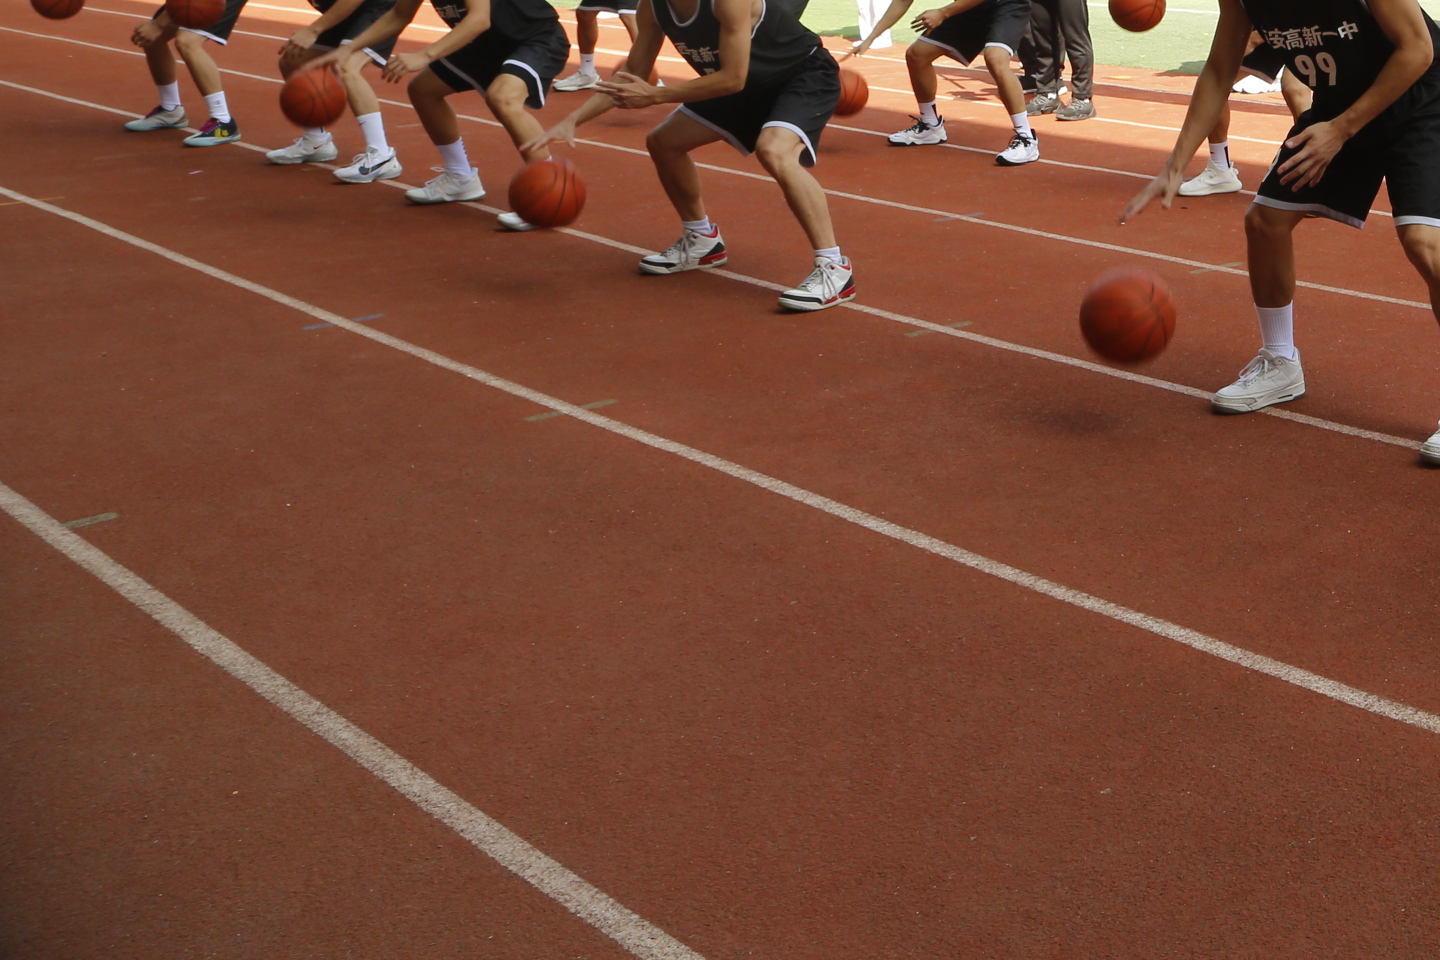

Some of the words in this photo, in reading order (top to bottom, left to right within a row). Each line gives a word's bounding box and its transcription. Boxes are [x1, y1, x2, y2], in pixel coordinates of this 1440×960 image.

[1264, 20, 1359, 50] 安高新一中
[1294, 52, 1337, 87] 99
